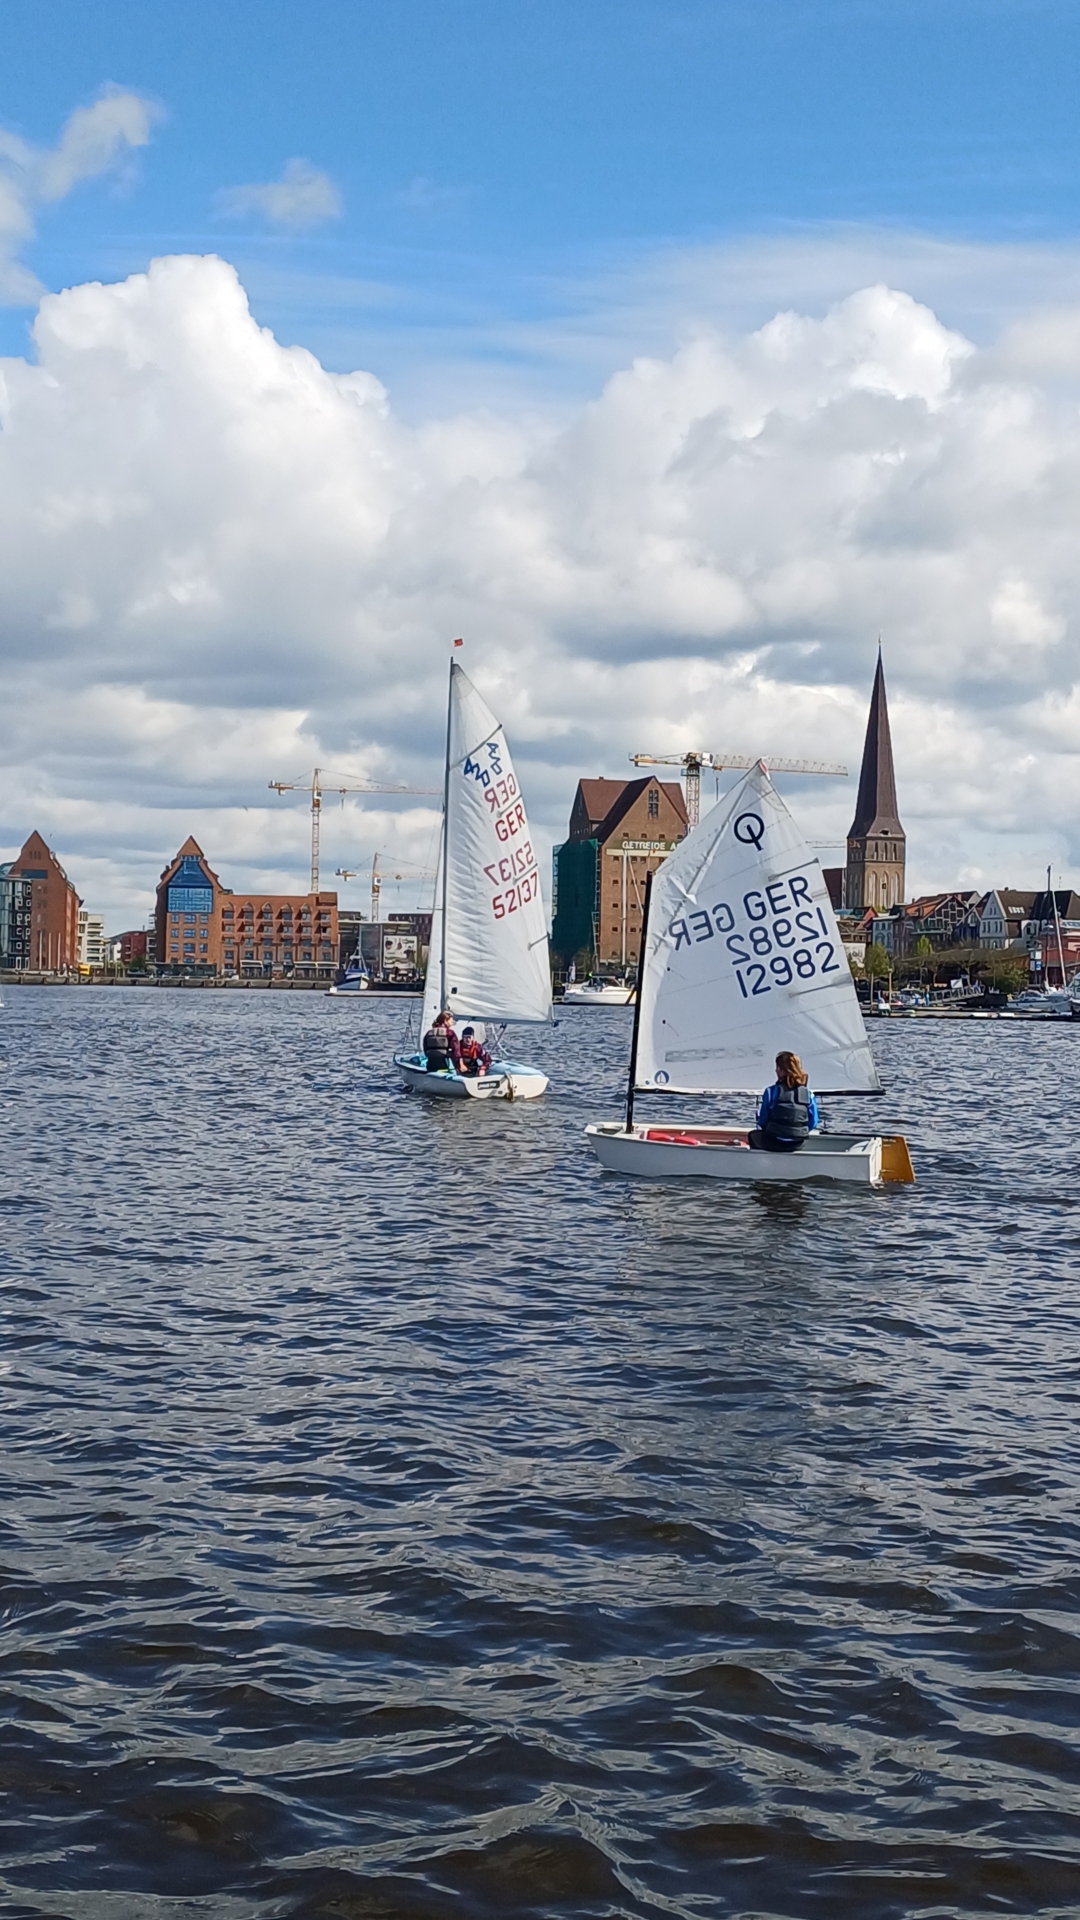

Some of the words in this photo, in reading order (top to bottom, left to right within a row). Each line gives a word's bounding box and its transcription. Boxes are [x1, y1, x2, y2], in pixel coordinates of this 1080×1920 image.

[463, 757, 490, 788] 420
[495, 803, 525, 842] GER
[621, 840, 666, 850] GETREIDE
[492, 871, 537, 919] 52137
[743, 876, 813, 921] GER
[736, 942, 840, 998] 12982
